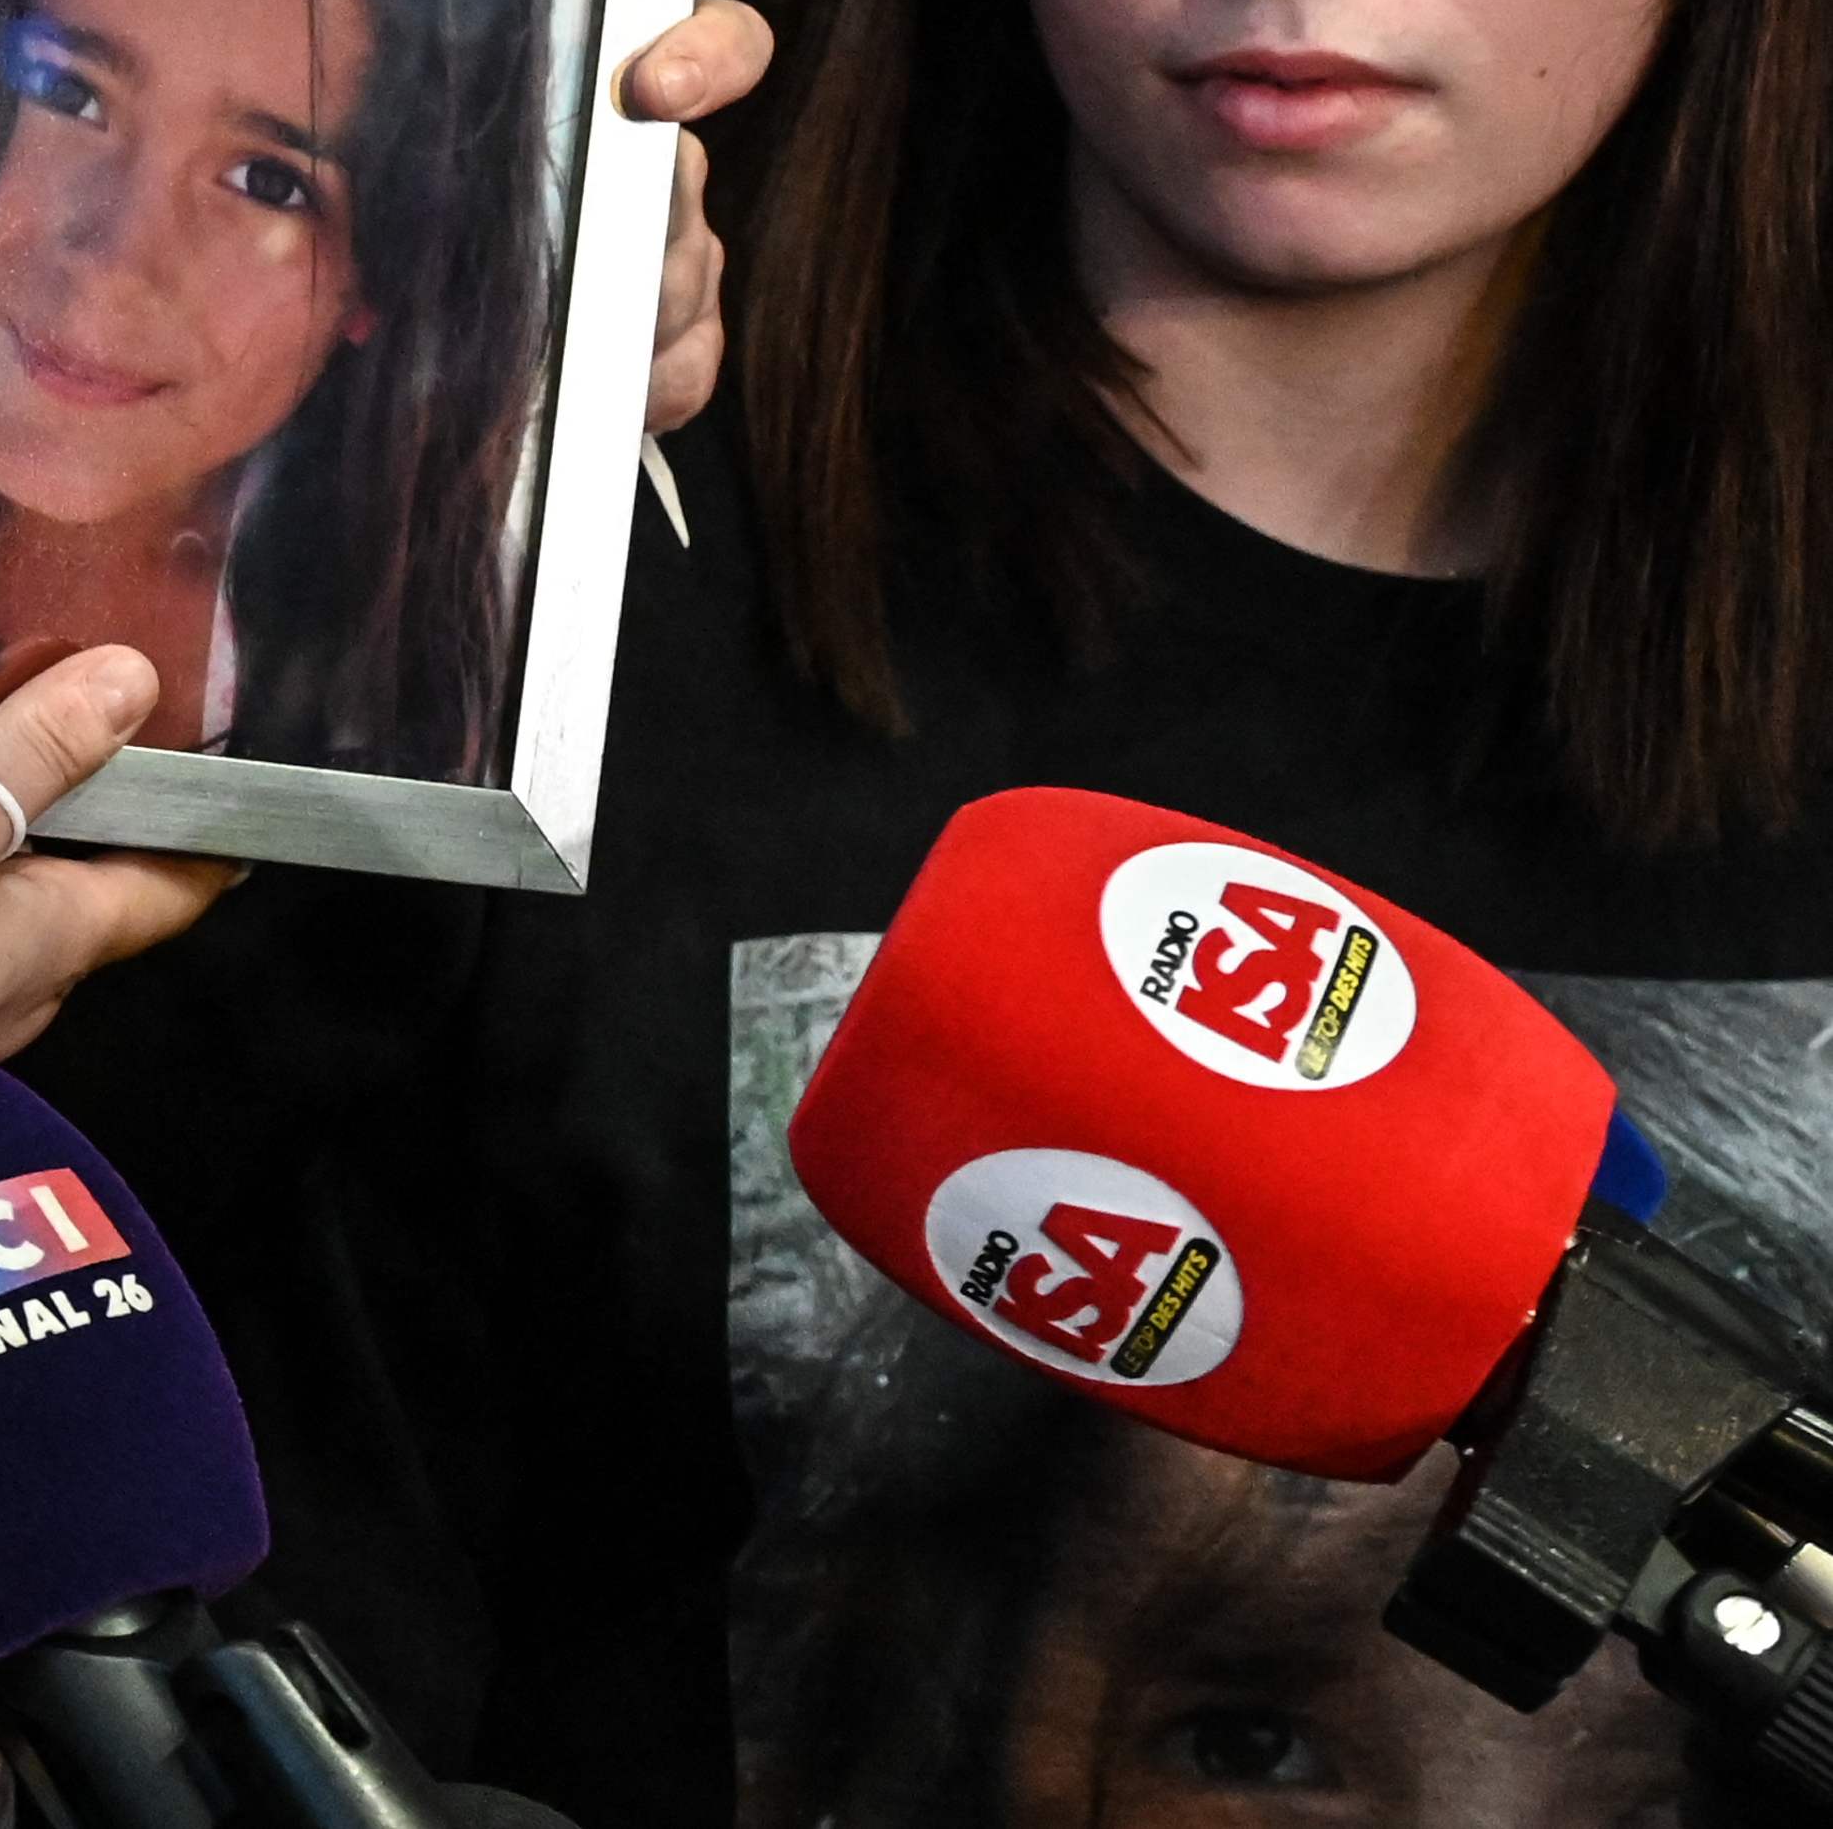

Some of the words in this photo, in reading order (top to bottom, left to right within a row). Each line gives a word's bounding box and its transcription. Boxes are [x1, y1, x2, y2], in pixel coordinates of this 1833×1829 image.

[1139, 909, 1200, 1006] RADIO
[1174, 881, 1342, 1064] ISA
[1329, 967, 1360, 1013] DES
[1344, 932, 1373, 976] HITS
[1314, 1004, 1341, 1045] TOP
[92, 1272, 155, 1320] 26
[959, 1230, 1020, 1308] RADIO
[991, 1201, 1183, 1365] ISA
[1148, 1291, 1182, 1331] DES
[1170, 1248, 1208, 1298] HITS
